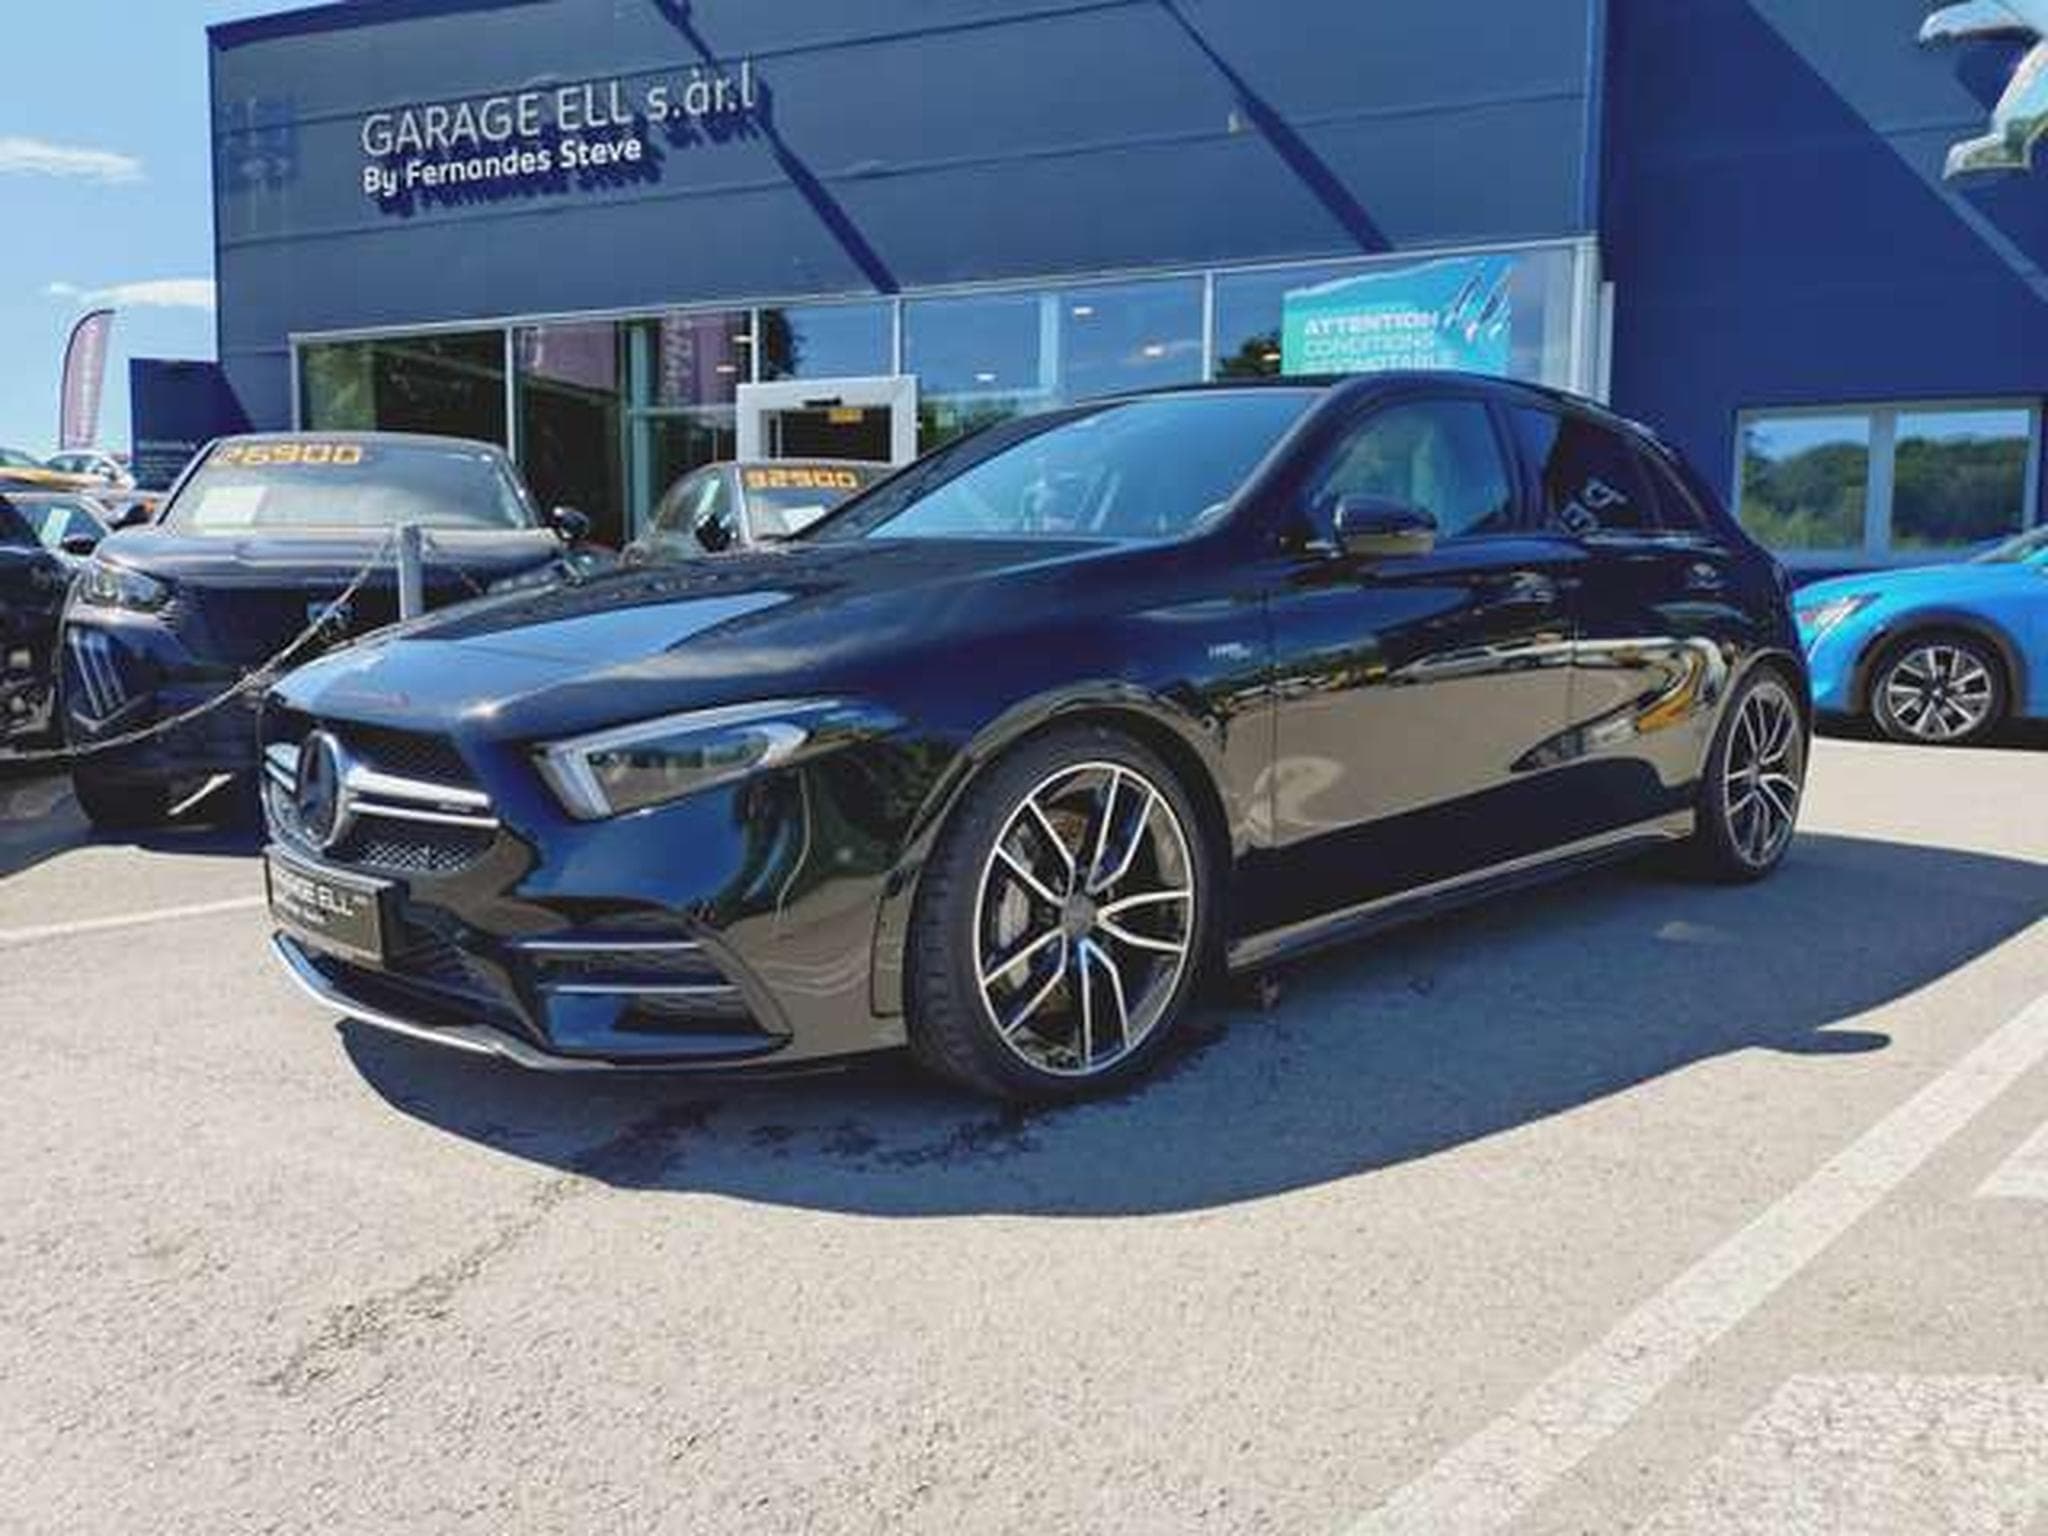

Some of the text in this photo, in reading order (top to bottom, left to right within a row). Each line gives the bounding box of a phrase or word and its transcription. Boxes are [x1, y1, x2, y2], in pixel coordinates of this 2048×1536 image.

[361, 61, 756, 157] GARAGE ELL s.àr.l
[363, 136, 642, 198] By Fernandes Steve
[1304, 311, 1438, 336] ATTENTION
